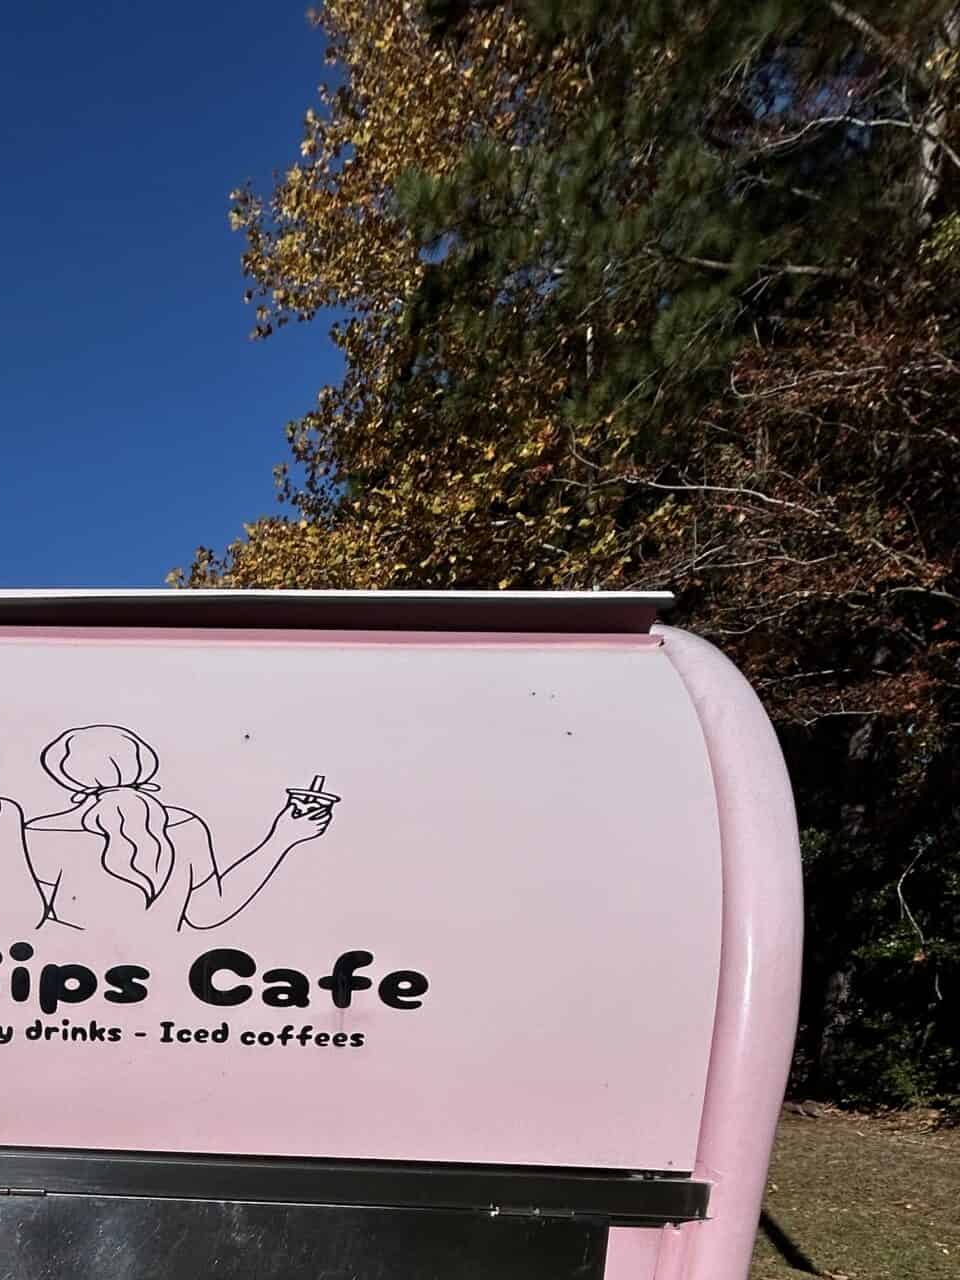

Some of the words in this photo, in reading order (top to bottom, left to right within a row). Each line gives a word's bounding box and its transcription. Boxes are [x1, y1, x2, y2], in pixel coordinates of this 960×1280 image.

[189, 948, 429, 1010] Cafe
[25, 1018, 122, 1042] drinks
[159, 1021, 230, 1044] Iced
[240, 1024, 365, 1048] coffees
